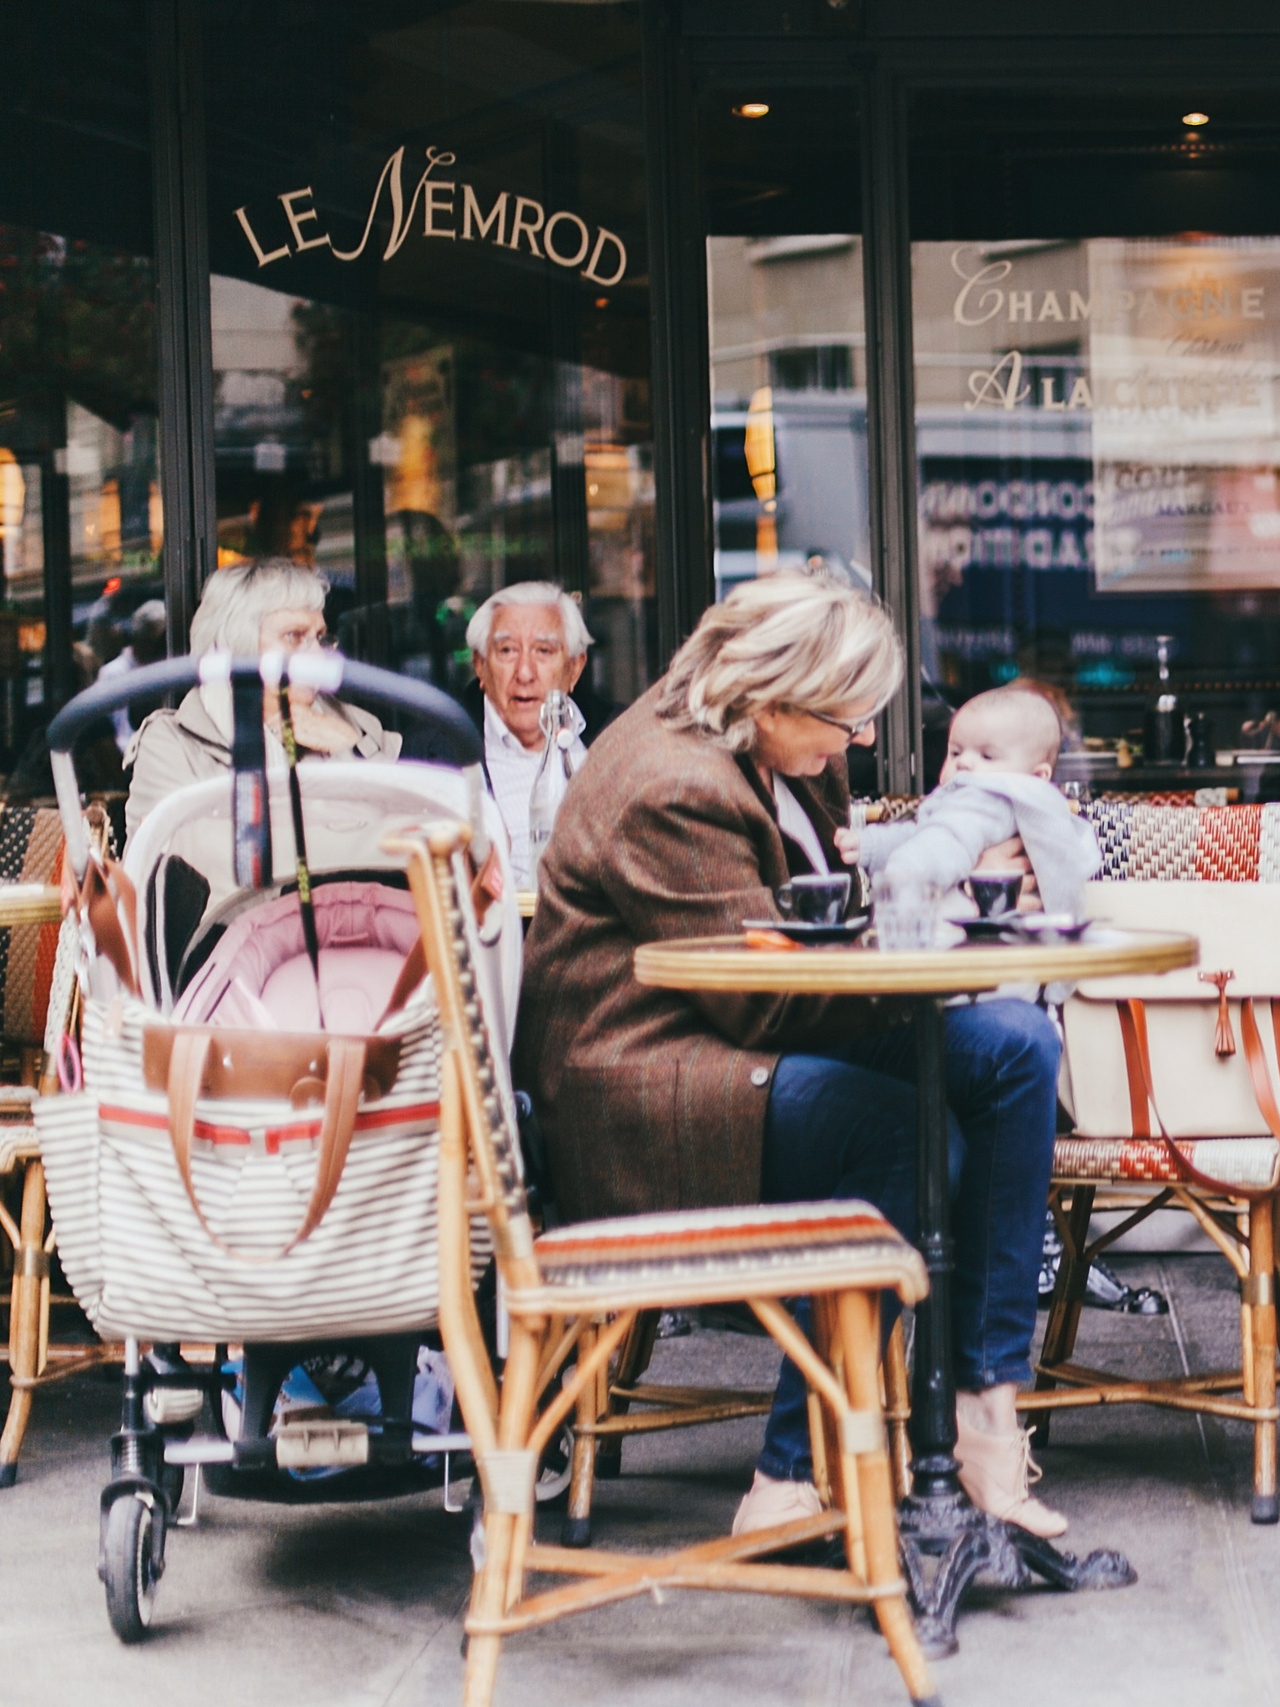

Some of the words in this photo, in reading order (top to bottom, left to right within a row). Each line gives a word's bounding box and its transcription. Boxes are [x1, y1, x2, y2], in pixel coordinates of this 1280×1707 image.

[233, 185, 331, 268] LE
[332, 145, 627, 288] NEMROD
[951, 244, 1266, 326] CHAMPAGNE
[964, 350, 1031, 412] A
[1041, 372, 1094, 411] LA
